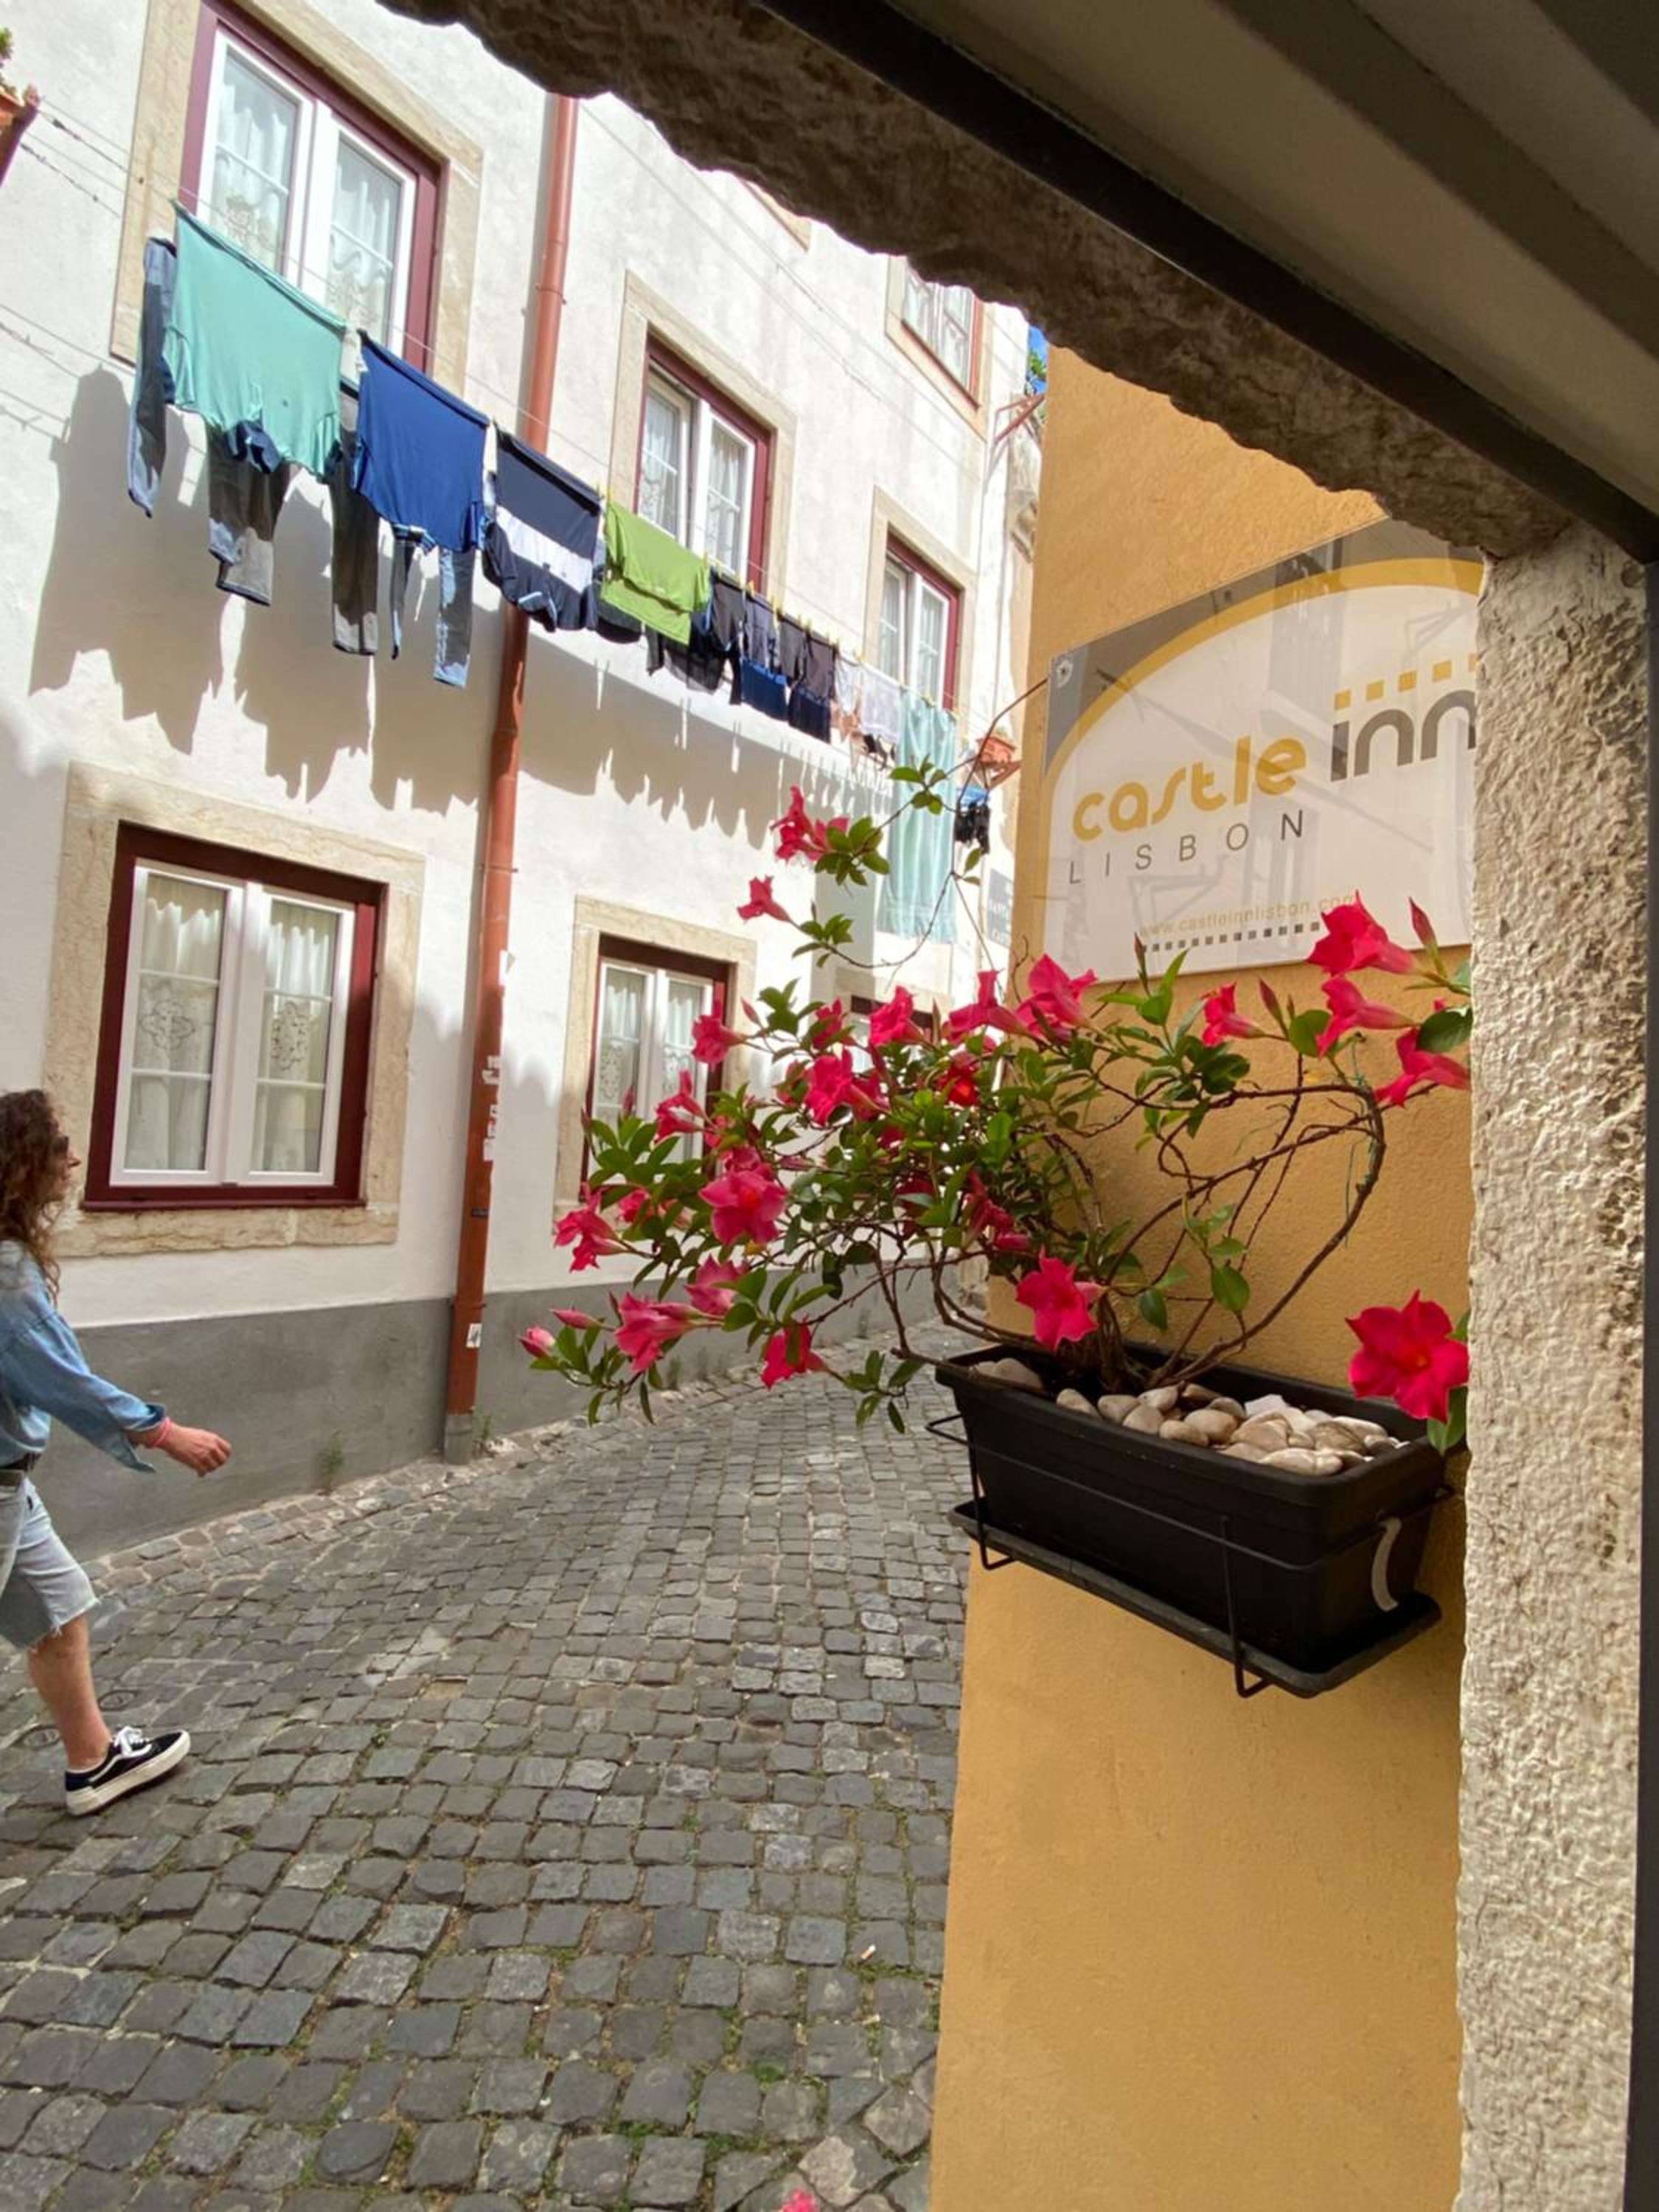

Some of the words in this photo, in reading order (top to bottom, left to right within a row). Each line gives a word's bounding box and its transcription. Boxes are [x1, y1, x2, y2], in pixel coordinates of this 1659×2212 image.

[1074, 736, 1305, 841] castle
[1330, 689, 1476, 783] inn
[1070, 809, 1304, 885] LISBON
